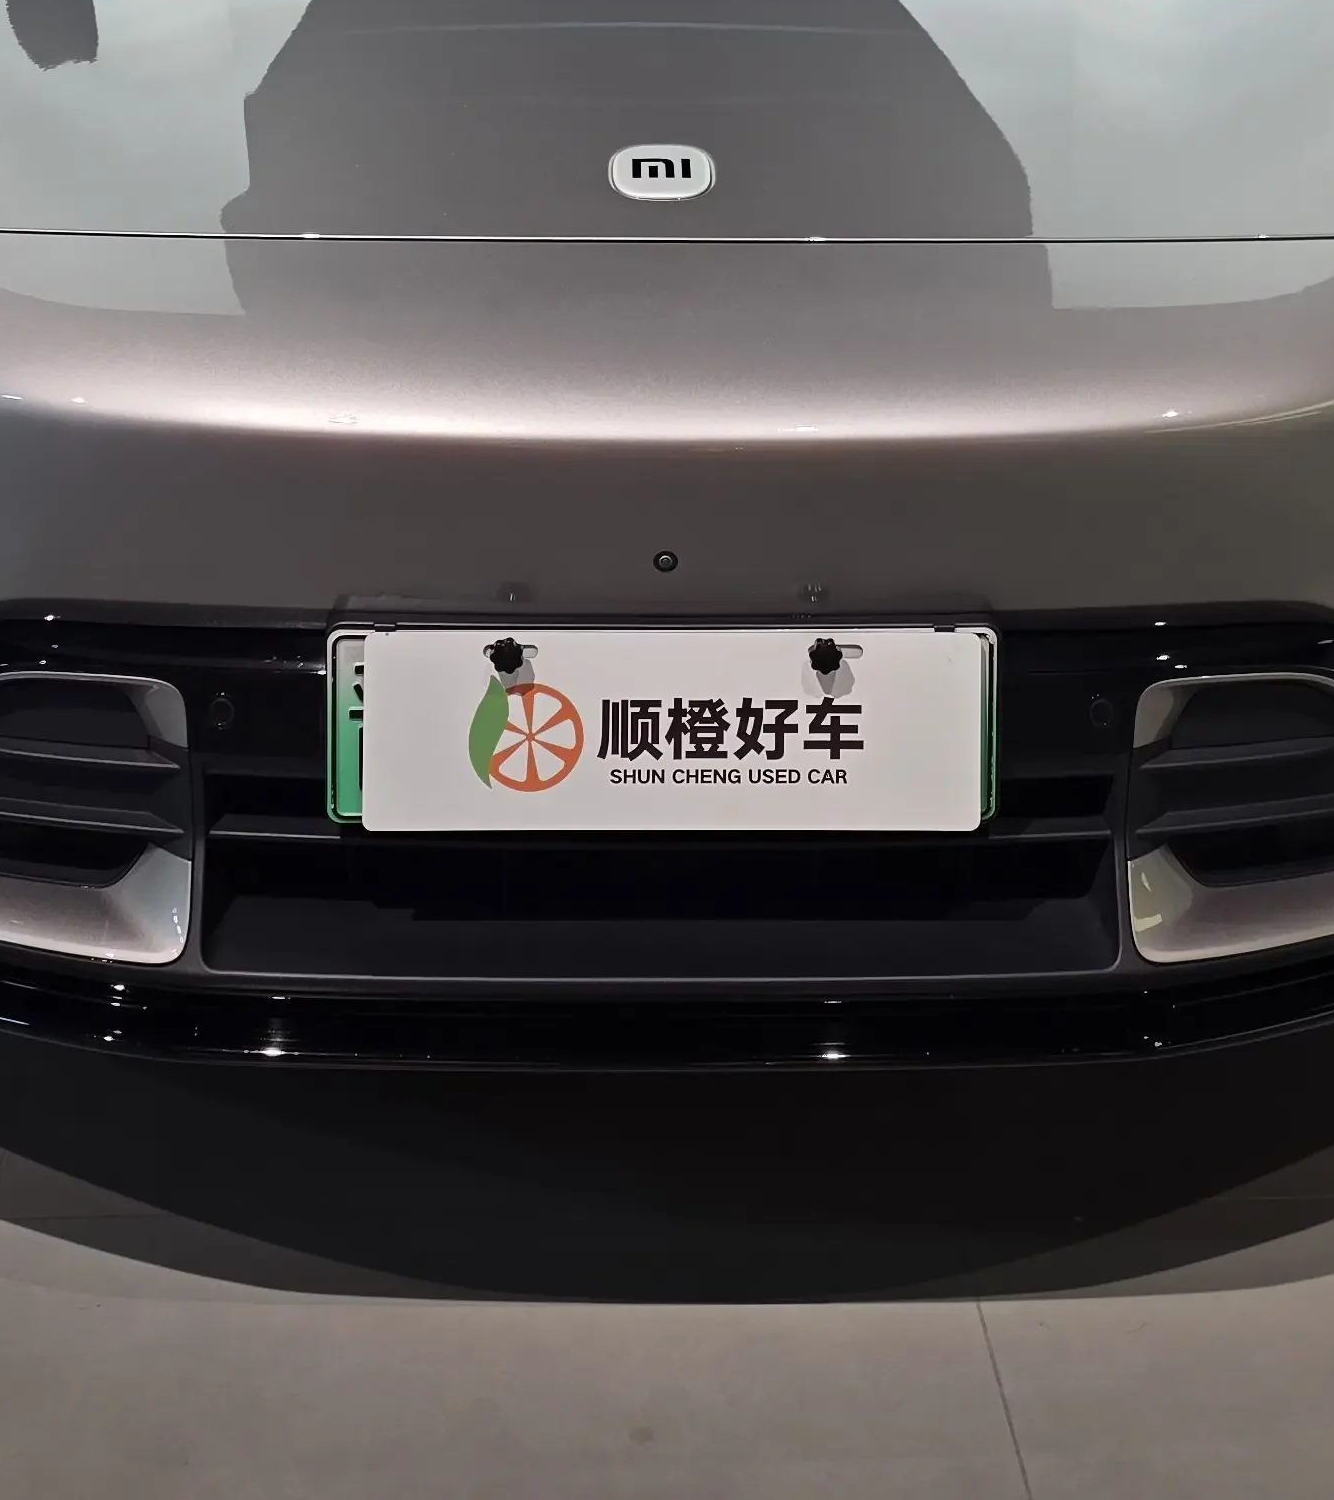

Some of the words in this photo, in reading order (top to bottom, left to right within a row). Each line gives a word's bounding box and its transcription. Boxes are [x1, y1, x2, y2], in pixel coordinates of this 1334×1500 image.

[597, 697, 864, 761] 顺橙好车
[610, 769, 665, 784] SHUN
[672, 769, 742, 784] CHENG
[748, 769, 801, 784] USED
[807, 769, 848, 784] CAR
